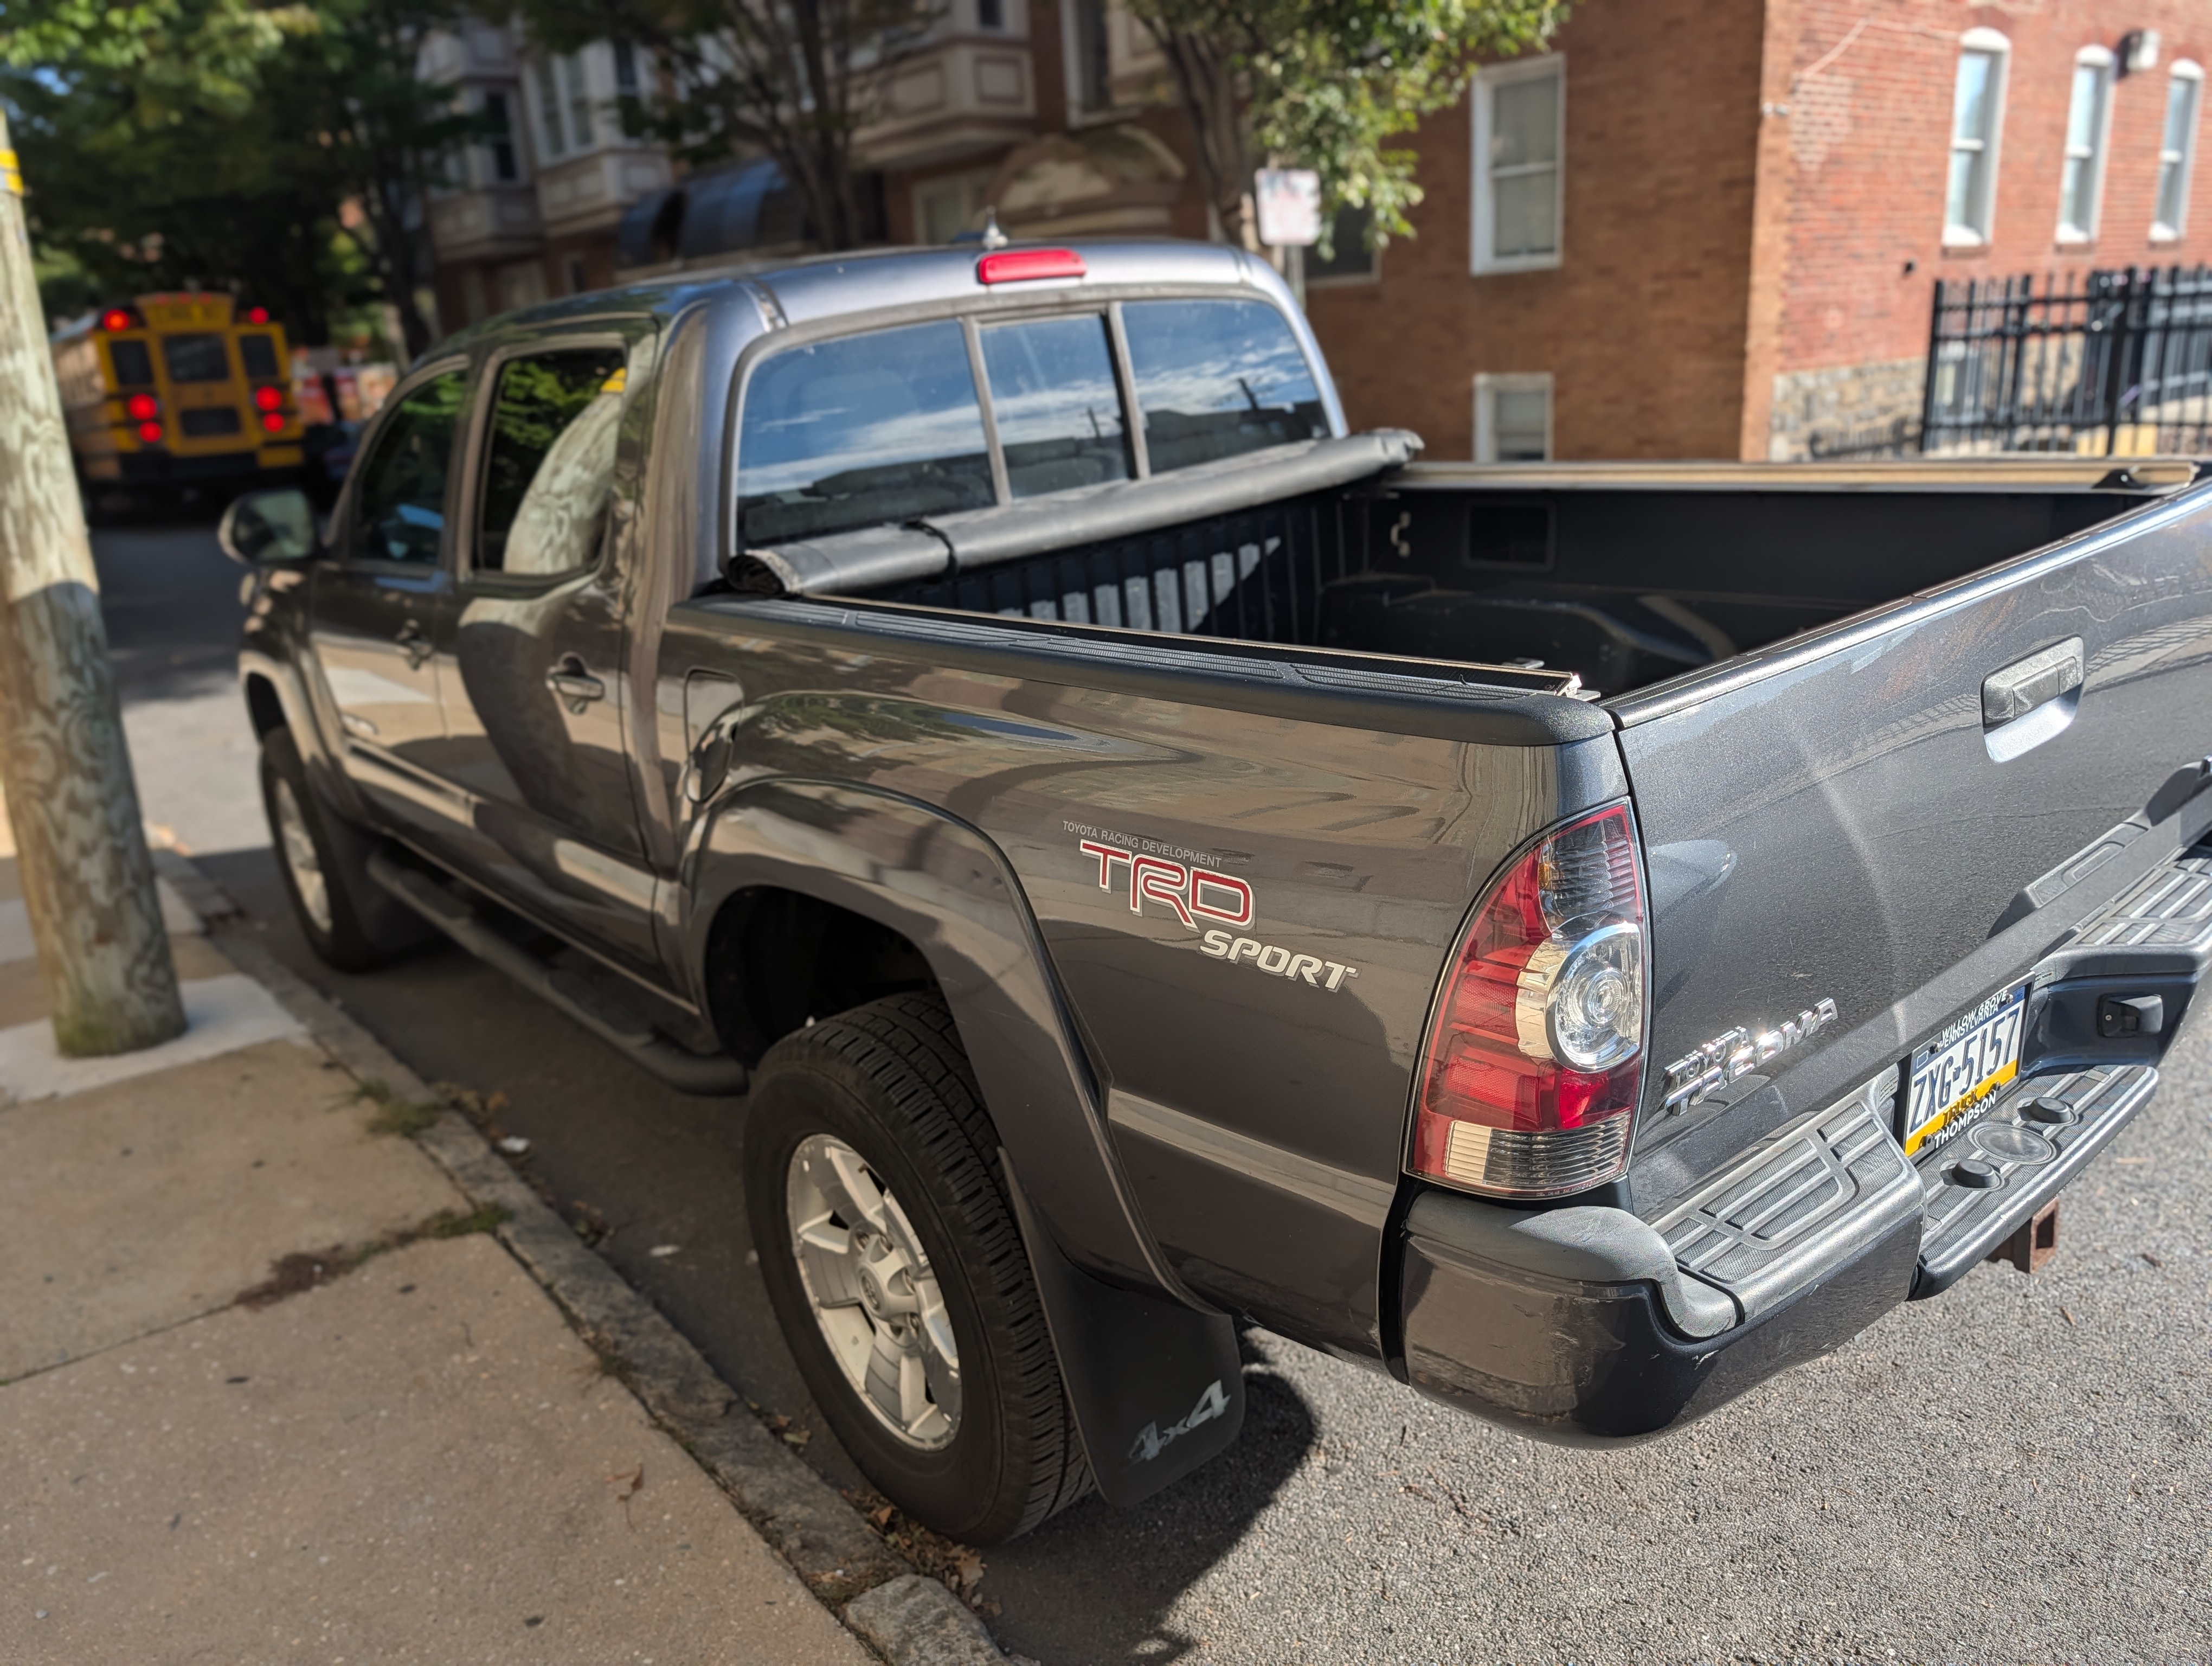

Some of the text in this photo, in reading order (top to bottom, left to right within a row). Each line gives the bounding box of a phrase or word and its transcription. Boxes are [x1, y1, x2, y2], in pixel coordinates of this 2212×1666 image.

[1063, 820, 1222, 868] TOYOTA RACING DEVELOPMENT
[1079, 838, 1255, 931] TRD
[1200, 930, 1358, 991] SPORT
[1941, 990, 2008, 1040] WILLOW GROVE
[1664, 997, 1838, 1117] TACOMA
[1664, 1026, 1750, 1089] TOYOTA
[1934, 1091, 1997, 1149] THOMPSON
